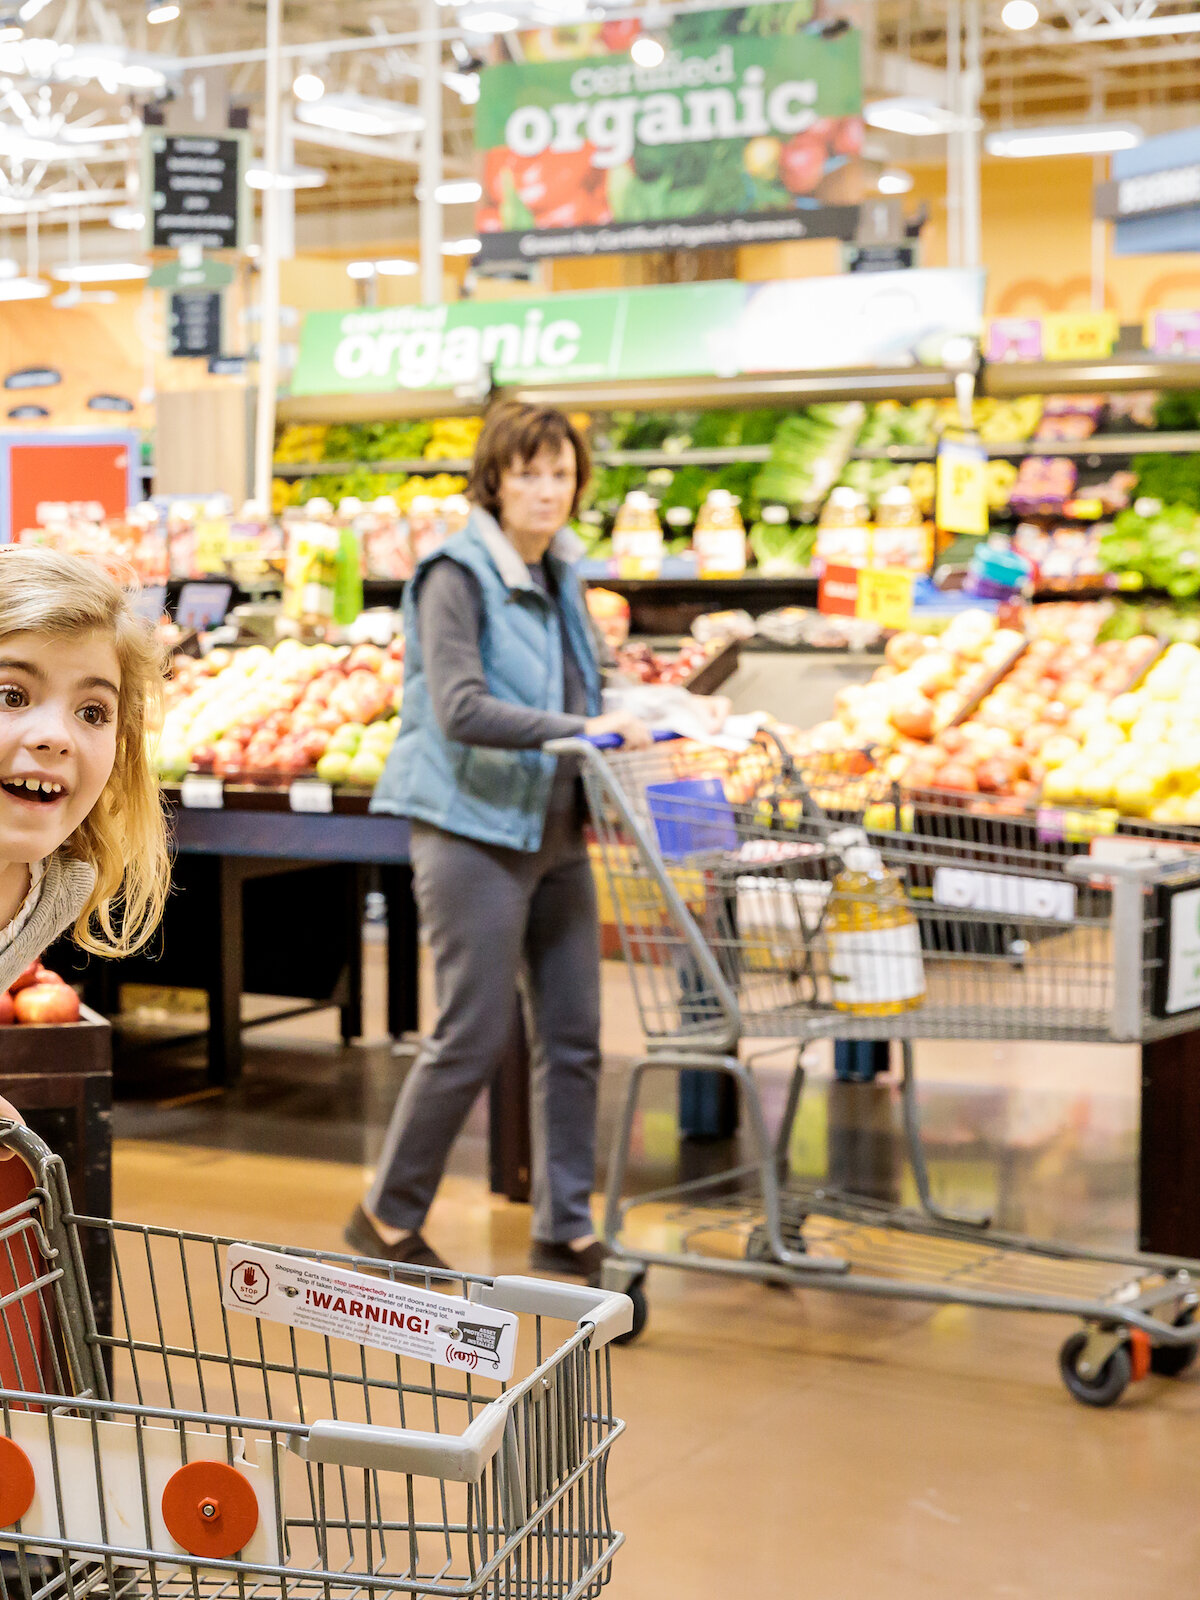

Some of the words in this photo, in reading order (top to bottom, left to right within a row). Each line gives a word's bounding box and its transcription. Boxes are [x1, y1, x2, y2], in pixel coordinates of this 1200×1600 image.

[570, 44, 736, 97] certified
[505, 65, 818, 168] organic
[335, 309, 581, 388] organic
[240, 1286, 257, 1295] STOP
[274, 1263, 302, 1276] Shopping
[303, 1270, 319, 1279] Carts
[347, 1282, 386, 1297] unexpectedly
[407, 1297, 424, 1305] doors
[453, 1308, 465, 1316] will
[305, 1288, 430, 1335] !WARNING!
[316, 1281, 332, 1289] taken
[367, 1294, 394, 1306] perimeter
[415, 1306, 438, 1317] parking
